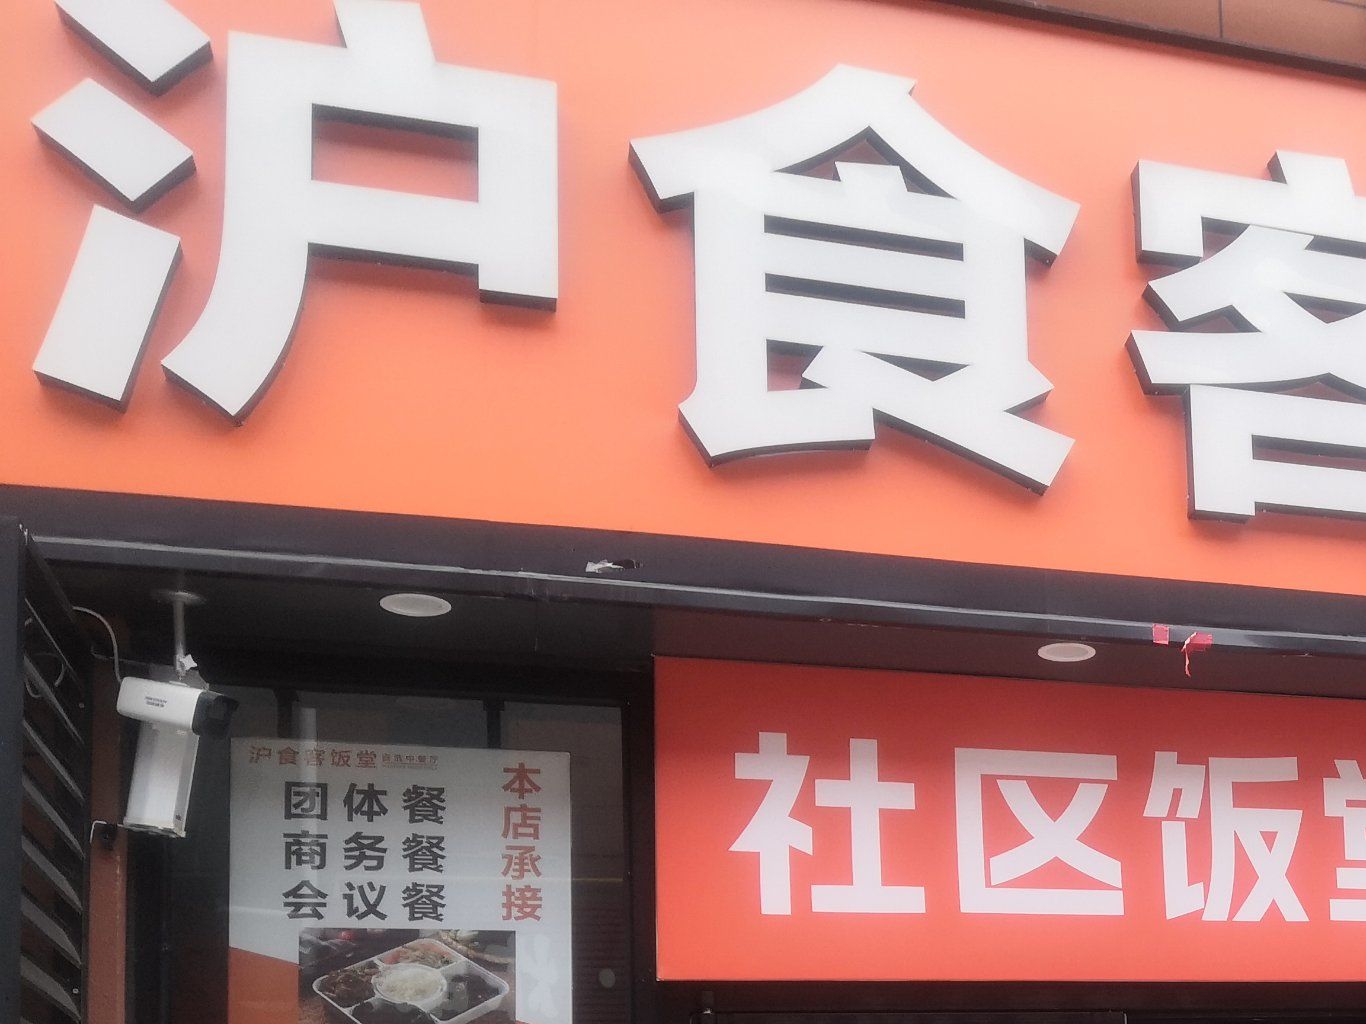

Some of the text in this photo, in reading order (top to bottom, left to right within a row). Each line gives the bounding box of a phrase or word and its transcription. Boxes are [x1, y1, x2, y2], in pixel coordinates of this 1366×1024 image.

[283, 781, 446, 825] 团体餐
[282, 830, 446, 874] 商务餐
[501, 762, 544, 922] 本店承接
[282, 879, 446, 922] 会议餐
